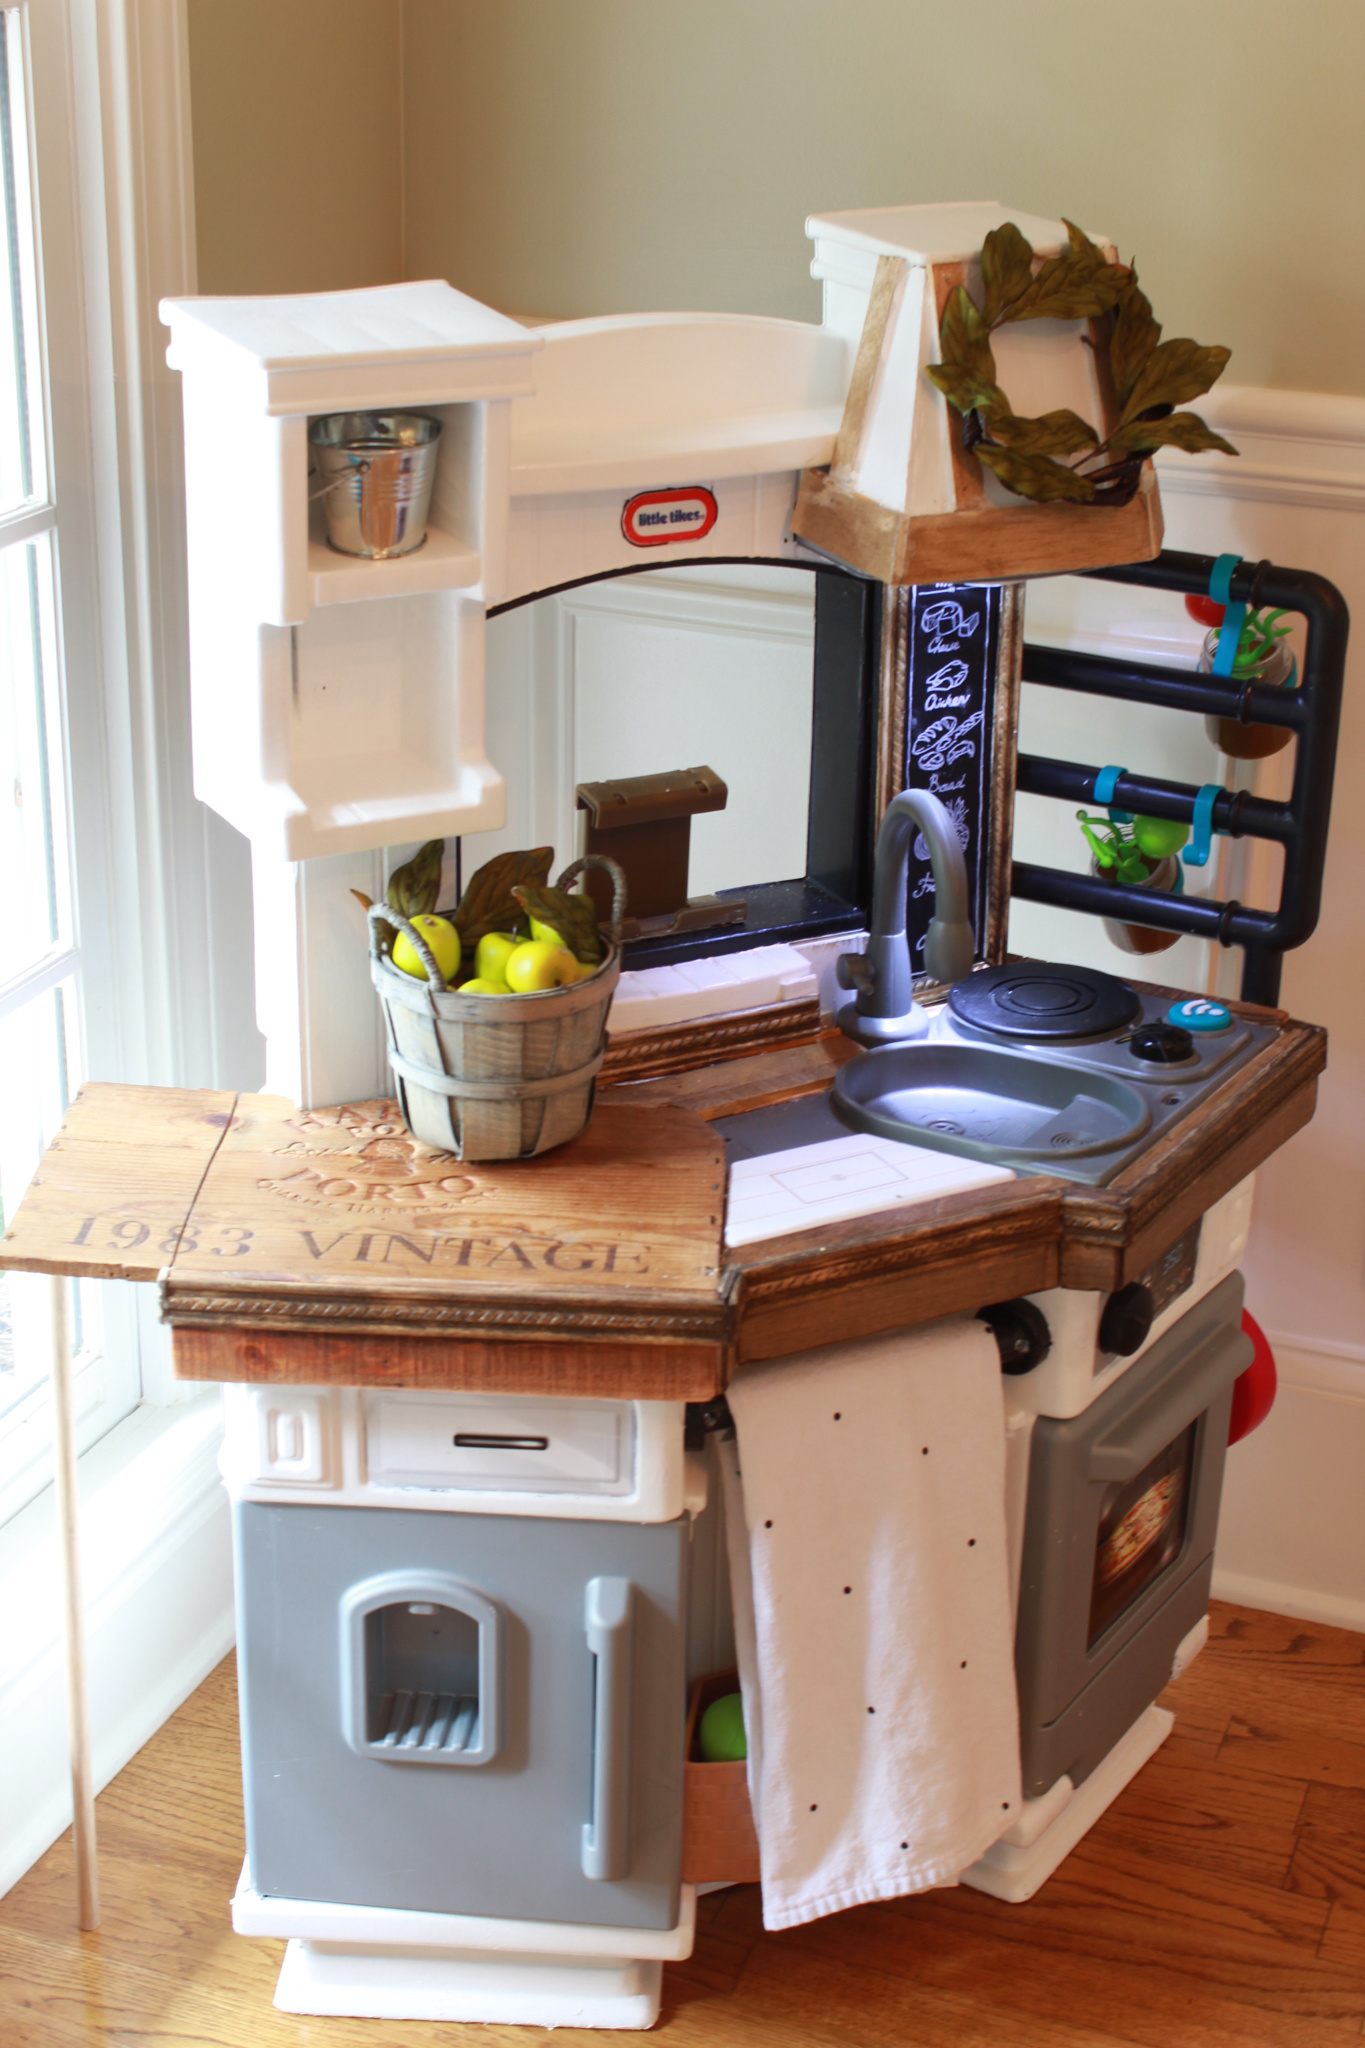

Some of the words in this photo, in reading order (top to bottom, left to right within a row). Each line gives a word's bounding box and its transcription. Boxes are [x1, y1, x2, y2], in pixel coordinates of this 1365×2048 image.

[638, 512, 668, 527] little
[279, 1167, 477, 1201] PORTO
[61, 1216, 254, 1257] 1983
[298, 1230, 652, 1275] VINTAGE
